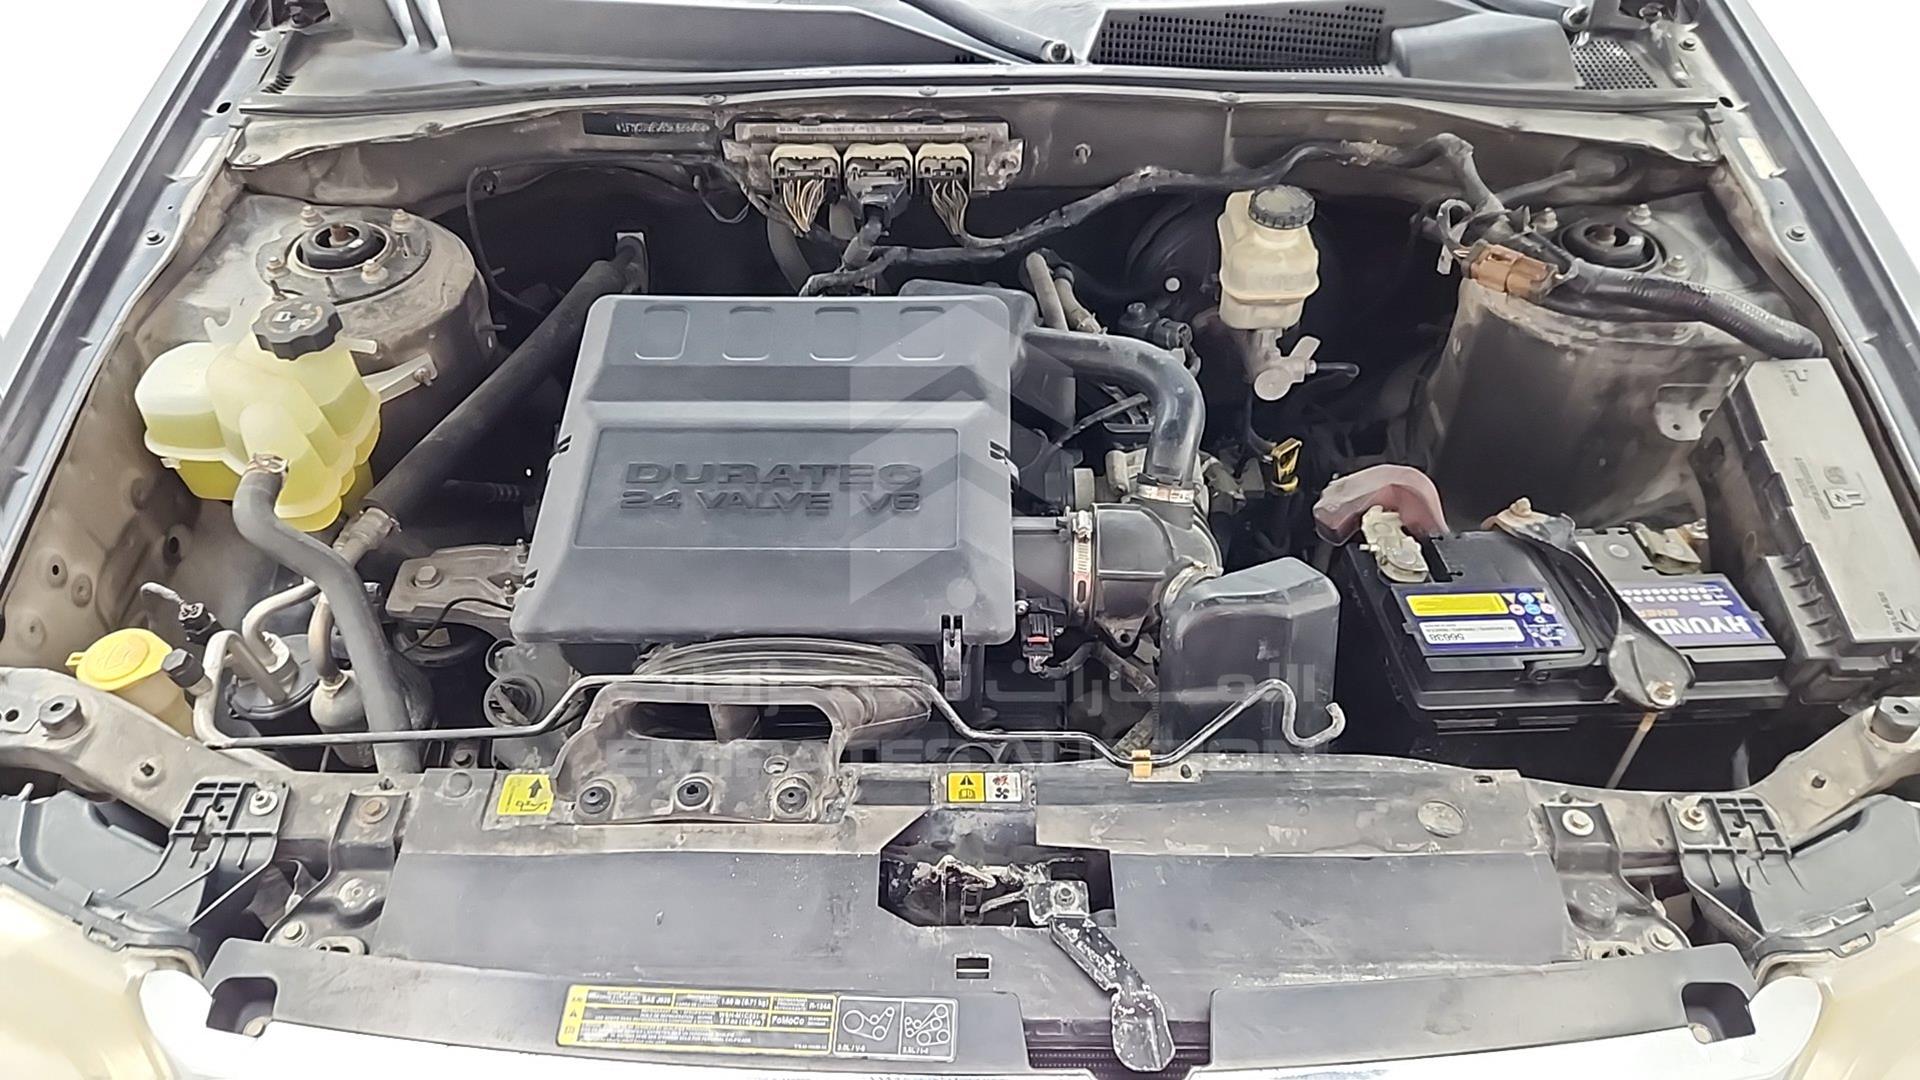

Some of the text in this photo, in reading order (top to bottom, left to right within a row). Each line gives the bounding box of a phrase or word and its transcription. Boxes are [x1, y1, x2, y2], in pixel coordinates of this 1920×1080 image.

[625, 463, 922, 491] DURATEC
[620, 490, 922, 513] 24 VALVE V6
[1637, 608, 1679, 618] ENER
[1648, 614, 1753, 636] HYUND
[771, 1015, 805, 1026] FoMoCo
